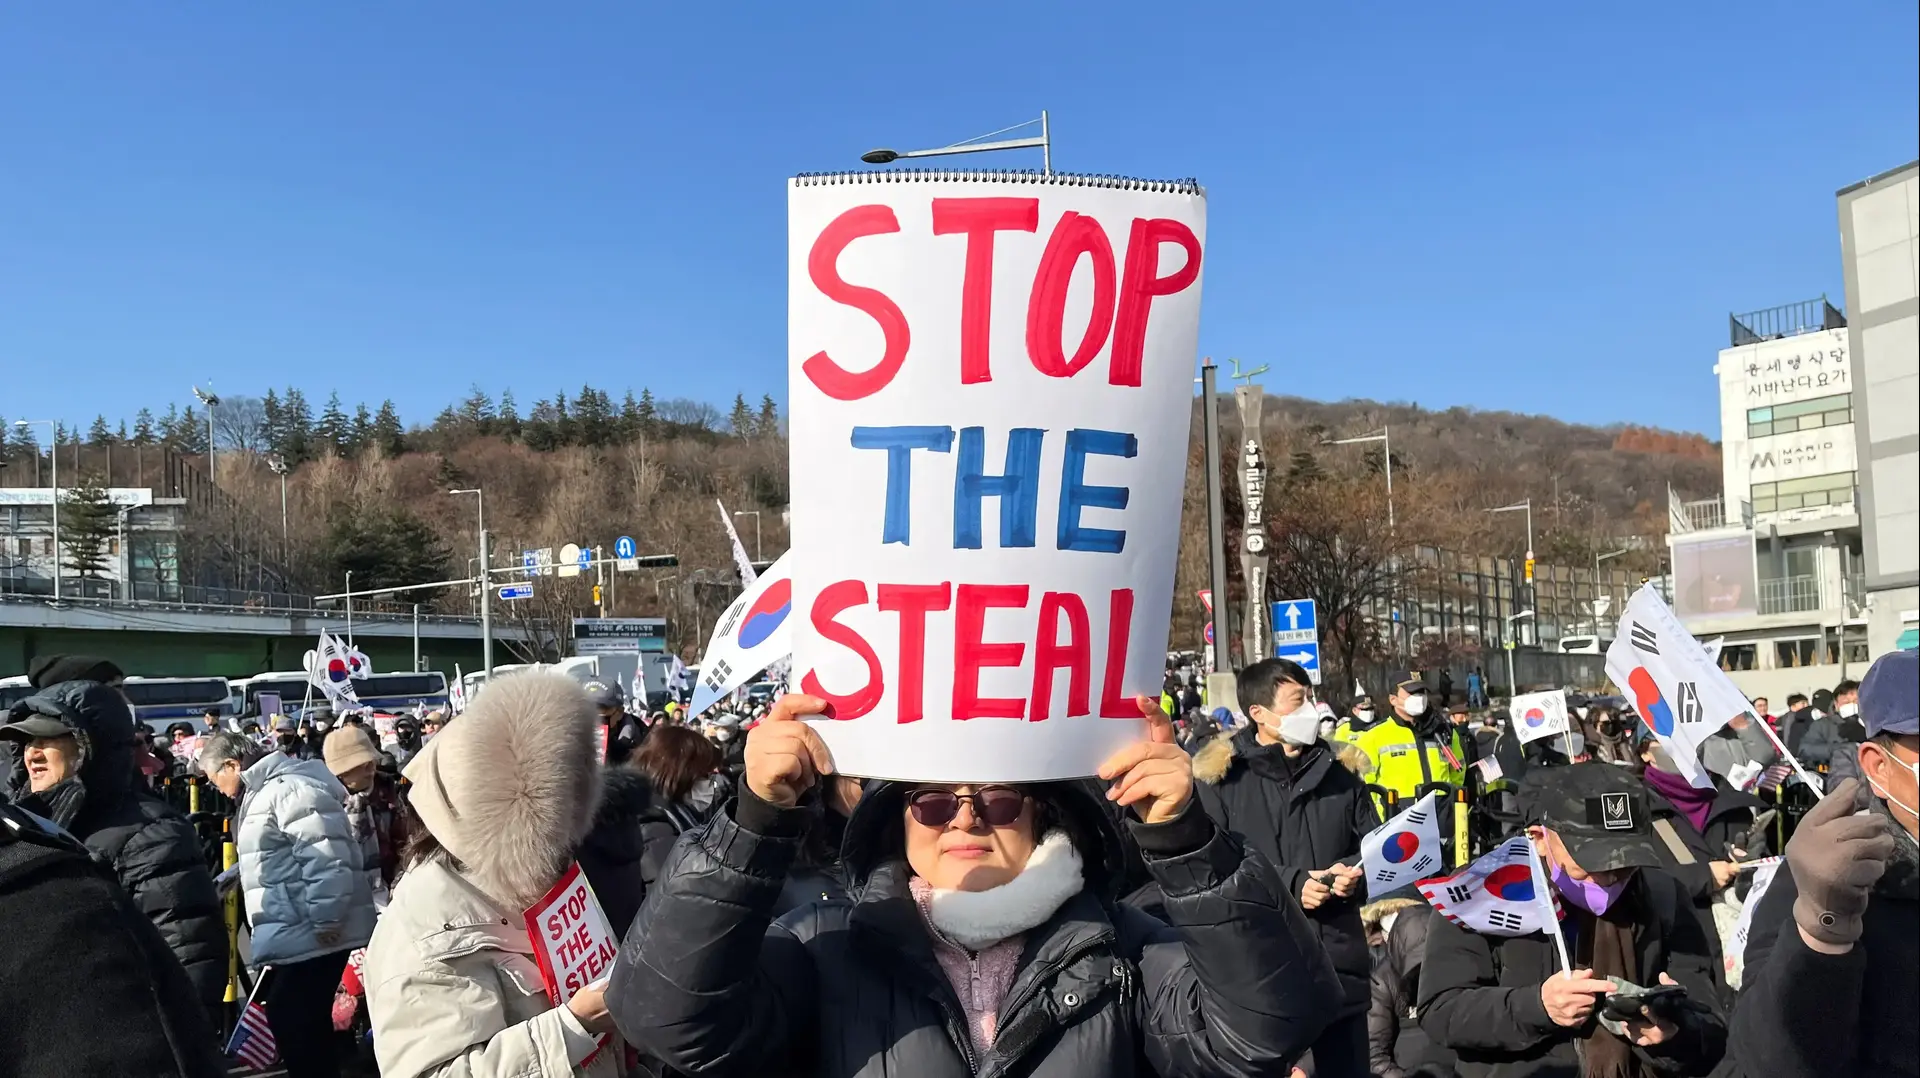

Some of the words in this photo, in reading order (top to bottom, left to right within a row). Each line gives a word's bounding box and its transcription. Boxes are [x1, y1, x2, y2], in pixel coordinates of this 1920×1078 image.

[802, 197, 1202, 400] STOP
[1783, 442, 1833, 455] MARIO
[1783, 455, 1817, 465] GYM
[851, 425, 1138, 553] THE
[801, 579, 1160, 724] STEAL
[1461, 831, 1469, 861] POL
[547, 885, 587, 941] STOP
[556, 922, 593, 970] THE
[565, 936, 617, 999] STEAL
